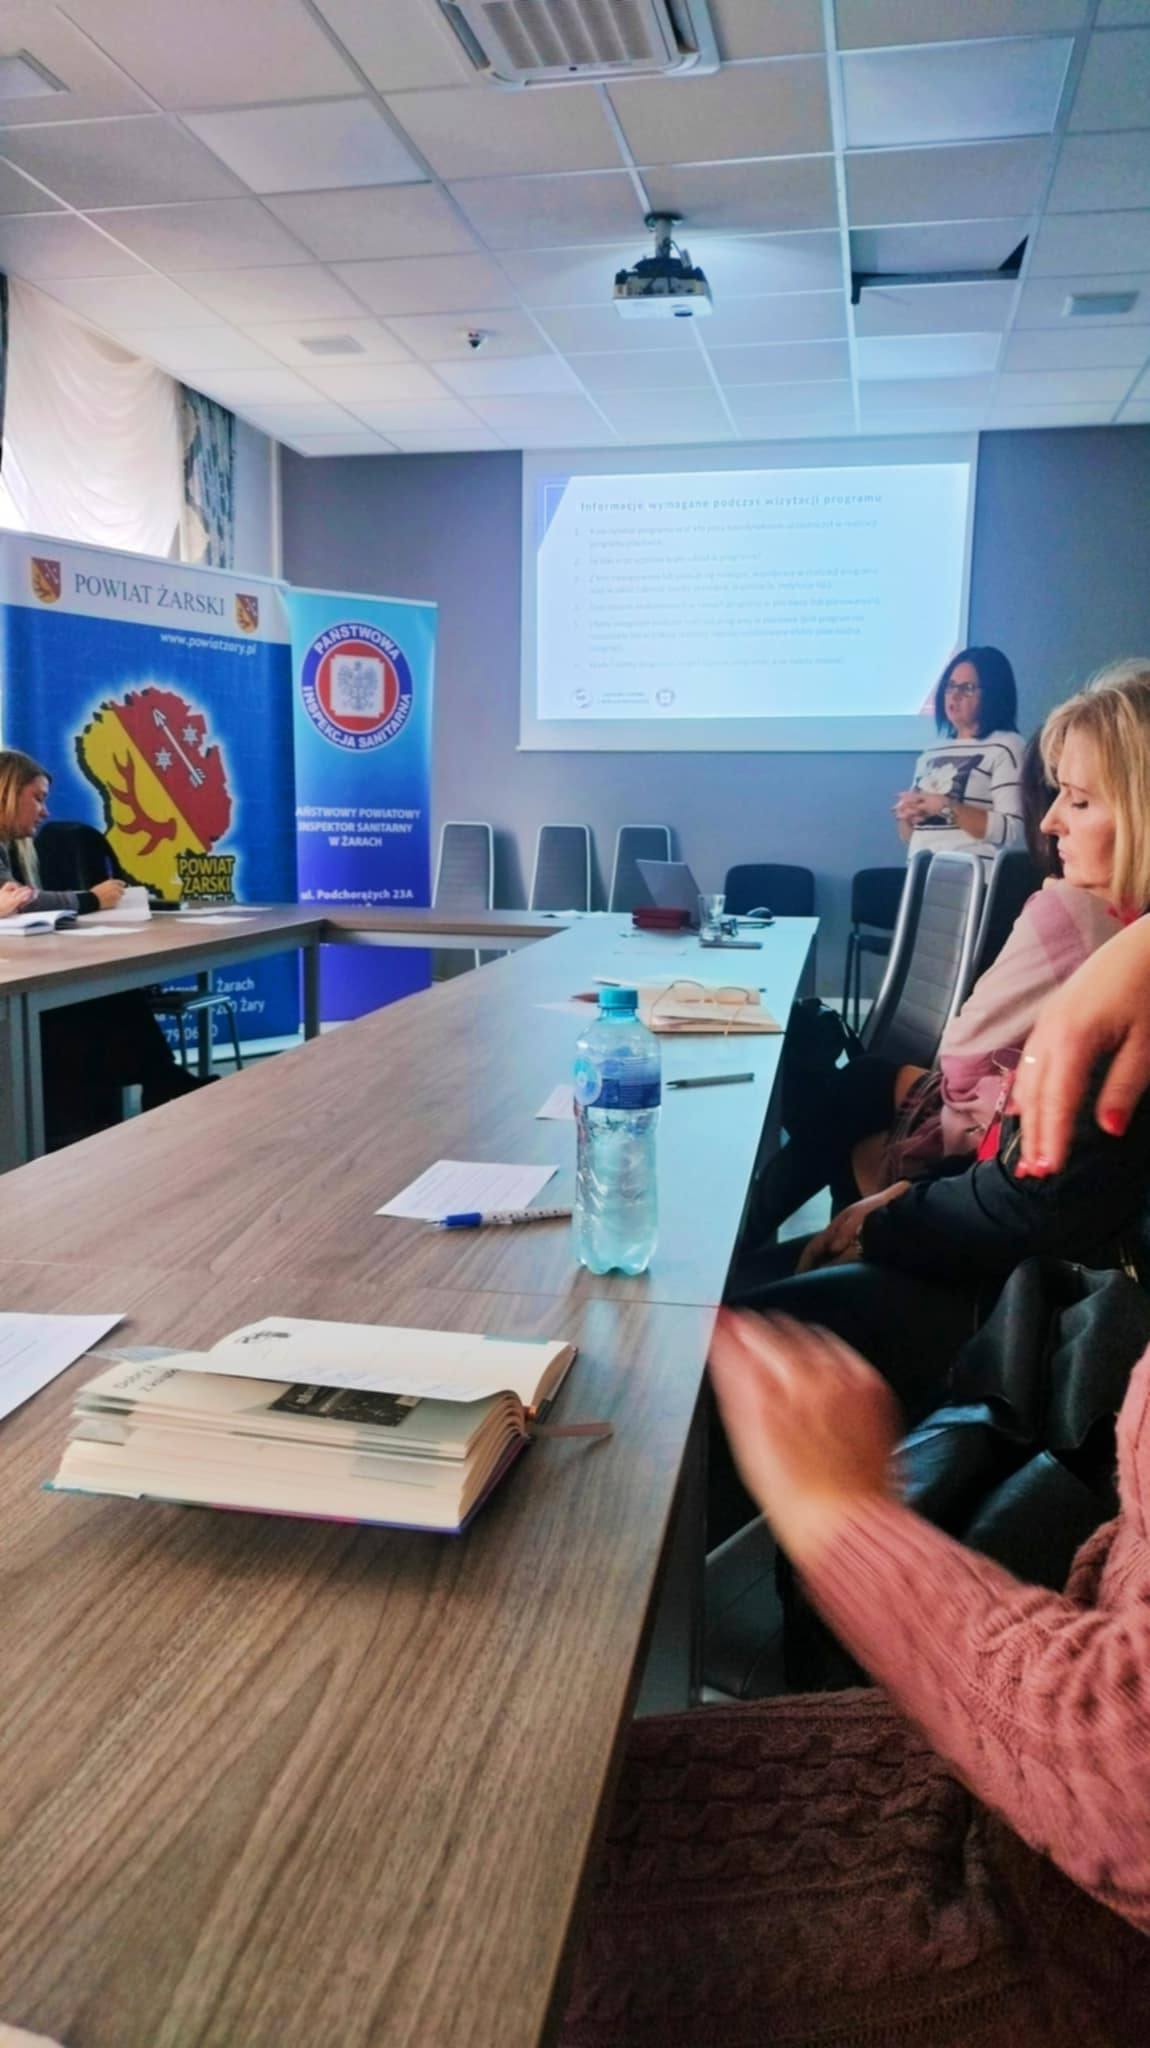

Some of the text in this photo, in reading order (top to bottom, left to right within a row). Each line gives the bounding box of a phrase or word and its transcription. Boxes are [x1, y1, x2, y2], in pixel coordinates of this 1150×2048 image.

[580, 494, 882, 513] Informacje wymagane podczas wizytacji programu
[74, 573, 225, 617] POWIAT ŻARSKI
[160, 632, 257, 656] www.powiatzary.pl
[303, 685, 412, 749] INSPEKCJA SANITARNA
[296, 806, 421, 819] AŃSTWOWY POWIATOWY
[357, 822, 413, 833] SANITARNY
[328, 834, 383, 847] W ŻARACH
[180, 858, 234, 875] POWIAT
[300, 889, 414, 902] ul. Podchorążych 23A
[216, 977, 255, 993] Żarach
[240, 996, 265, 1014] Żary
